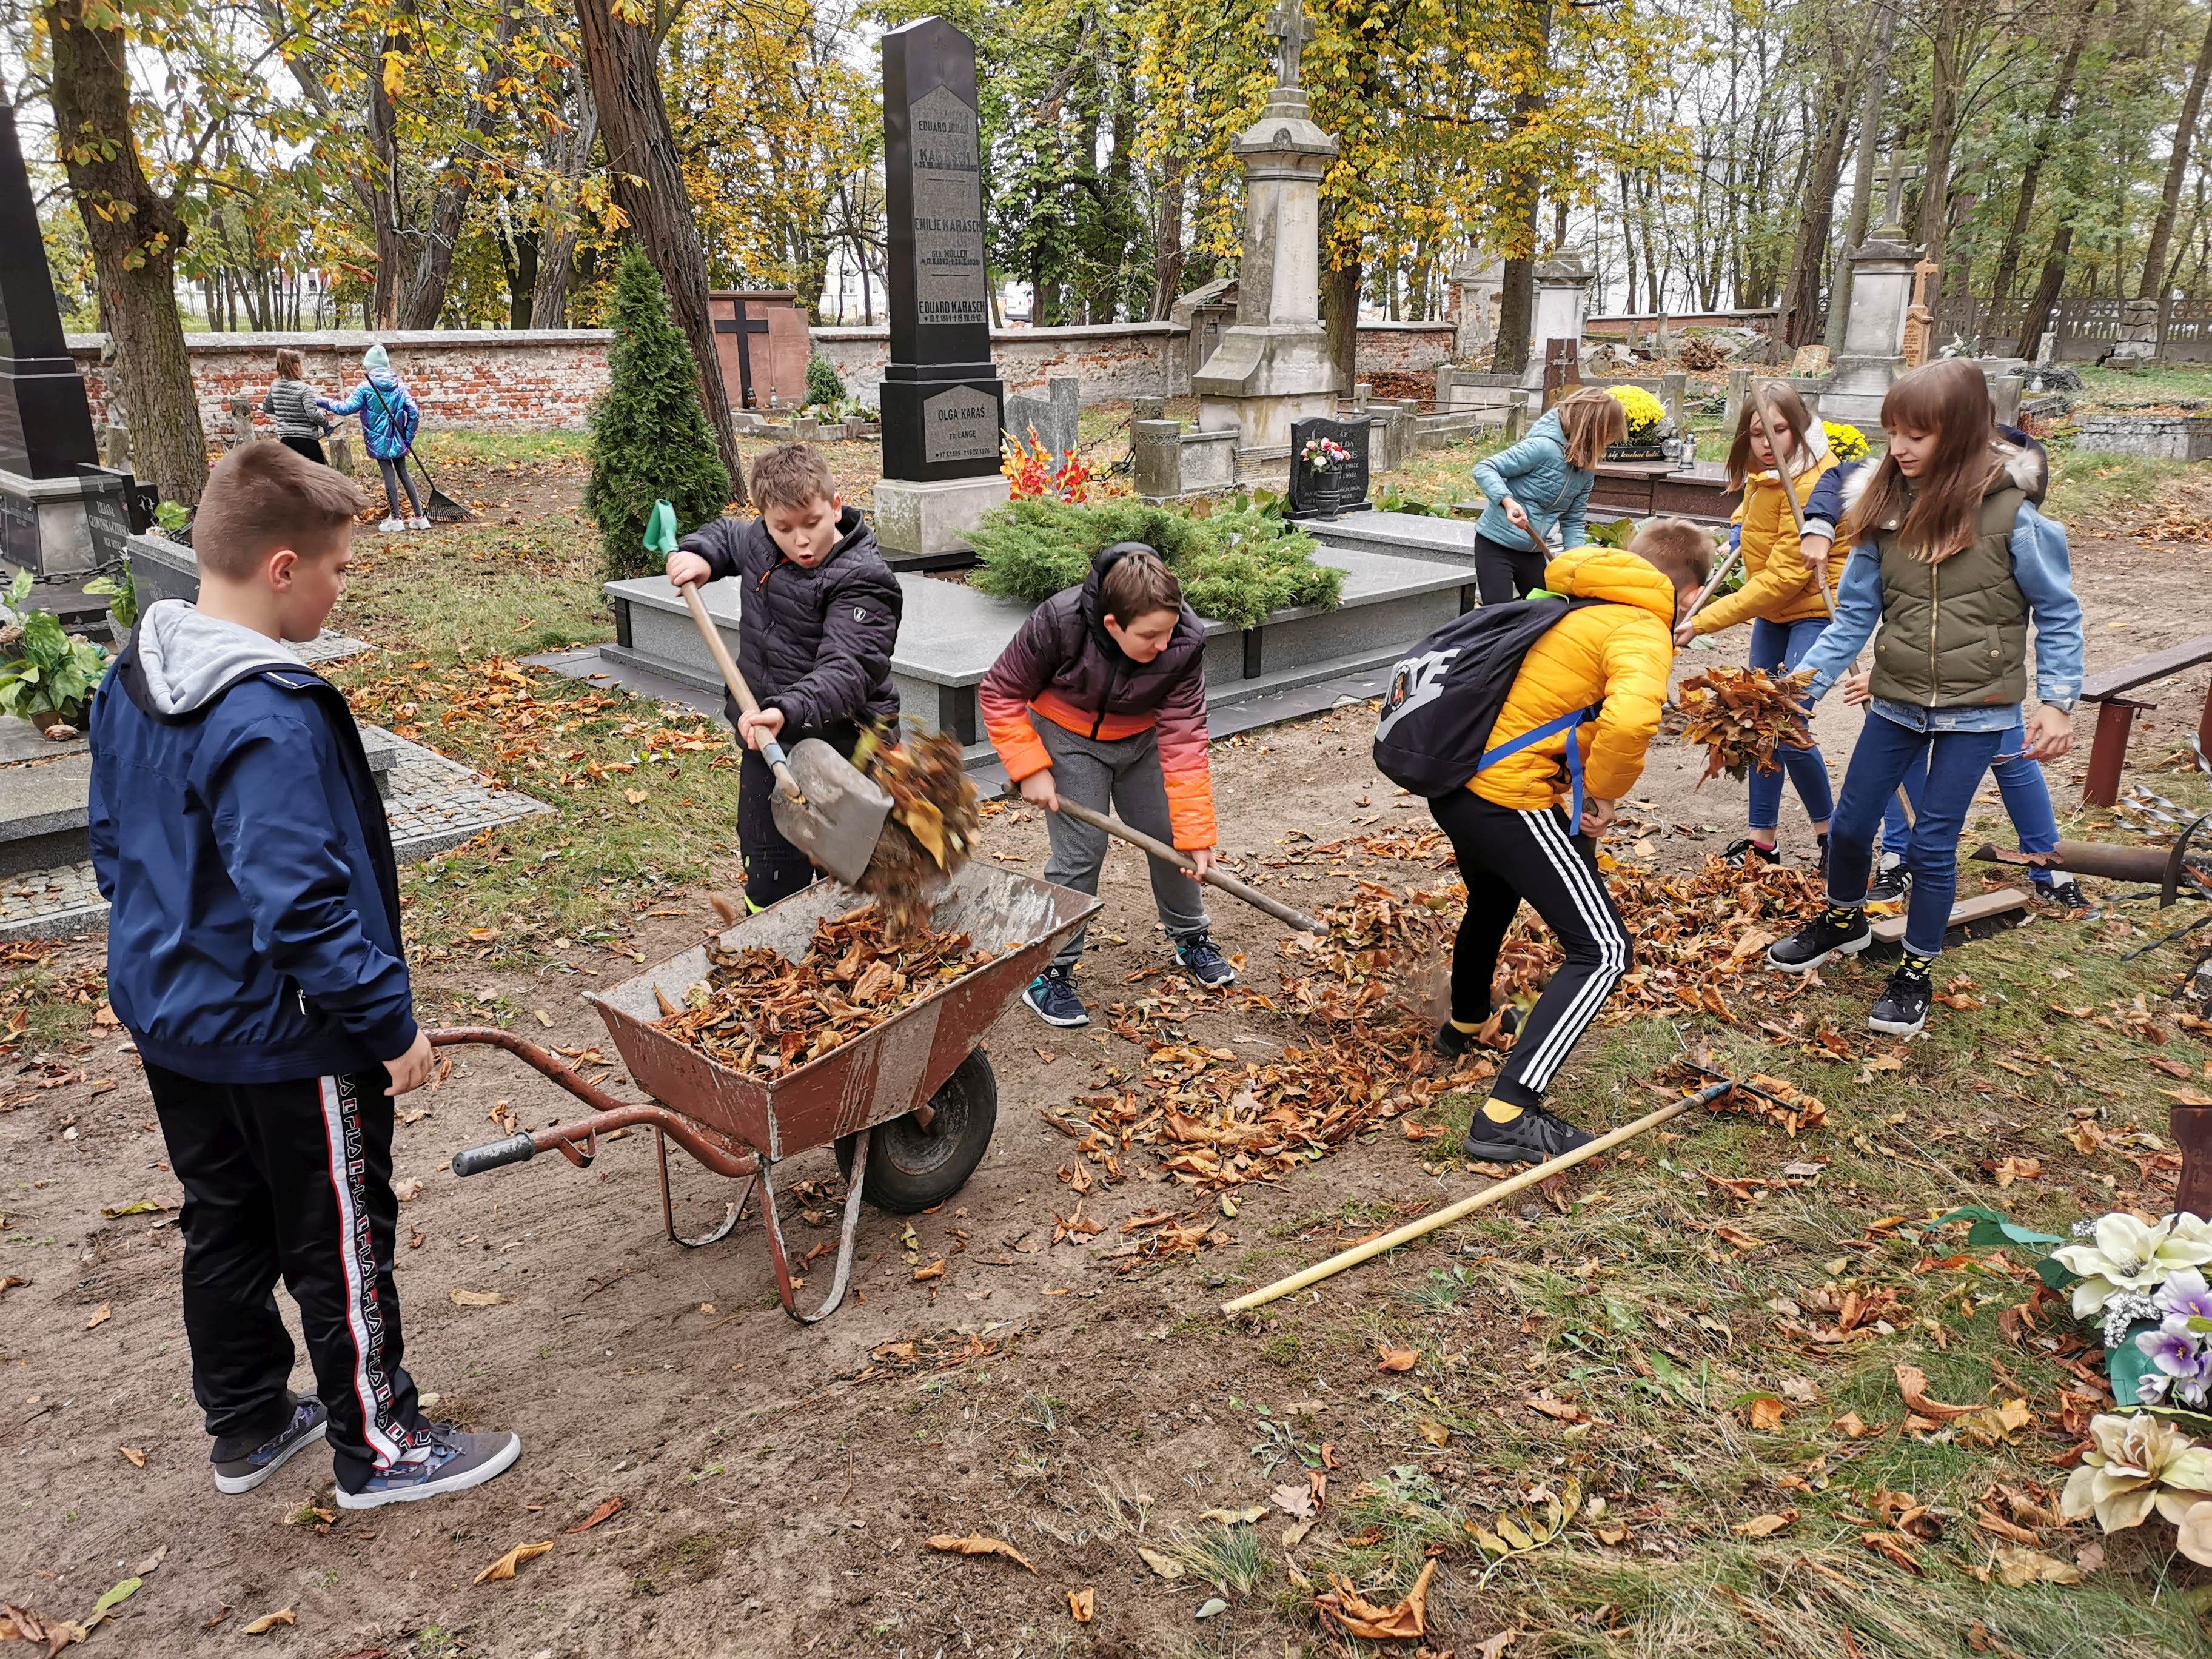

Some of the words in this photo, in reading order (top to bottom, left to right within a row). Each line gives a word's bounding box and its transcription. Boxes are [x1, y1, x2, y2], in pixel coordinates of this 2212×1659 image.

[919, 121, 947, 133] EDUARD
[919, 301, 950, 313] EDUARD
[951, 301, 985, 313] KARASCH
[938, 408, 959, 421] OLGA
[960, 403, 985, 419] KARAŚ
[957, 429, 976, 439] LANGE
[1905, 971, 1923, 981] FILA
[344, 1116, 362, 1159] FILA
[350, 1175, 366, 1217] FILA
[357, 1233, 375, 1276] FILA
[363, 1292, 383, 1334] FILA
